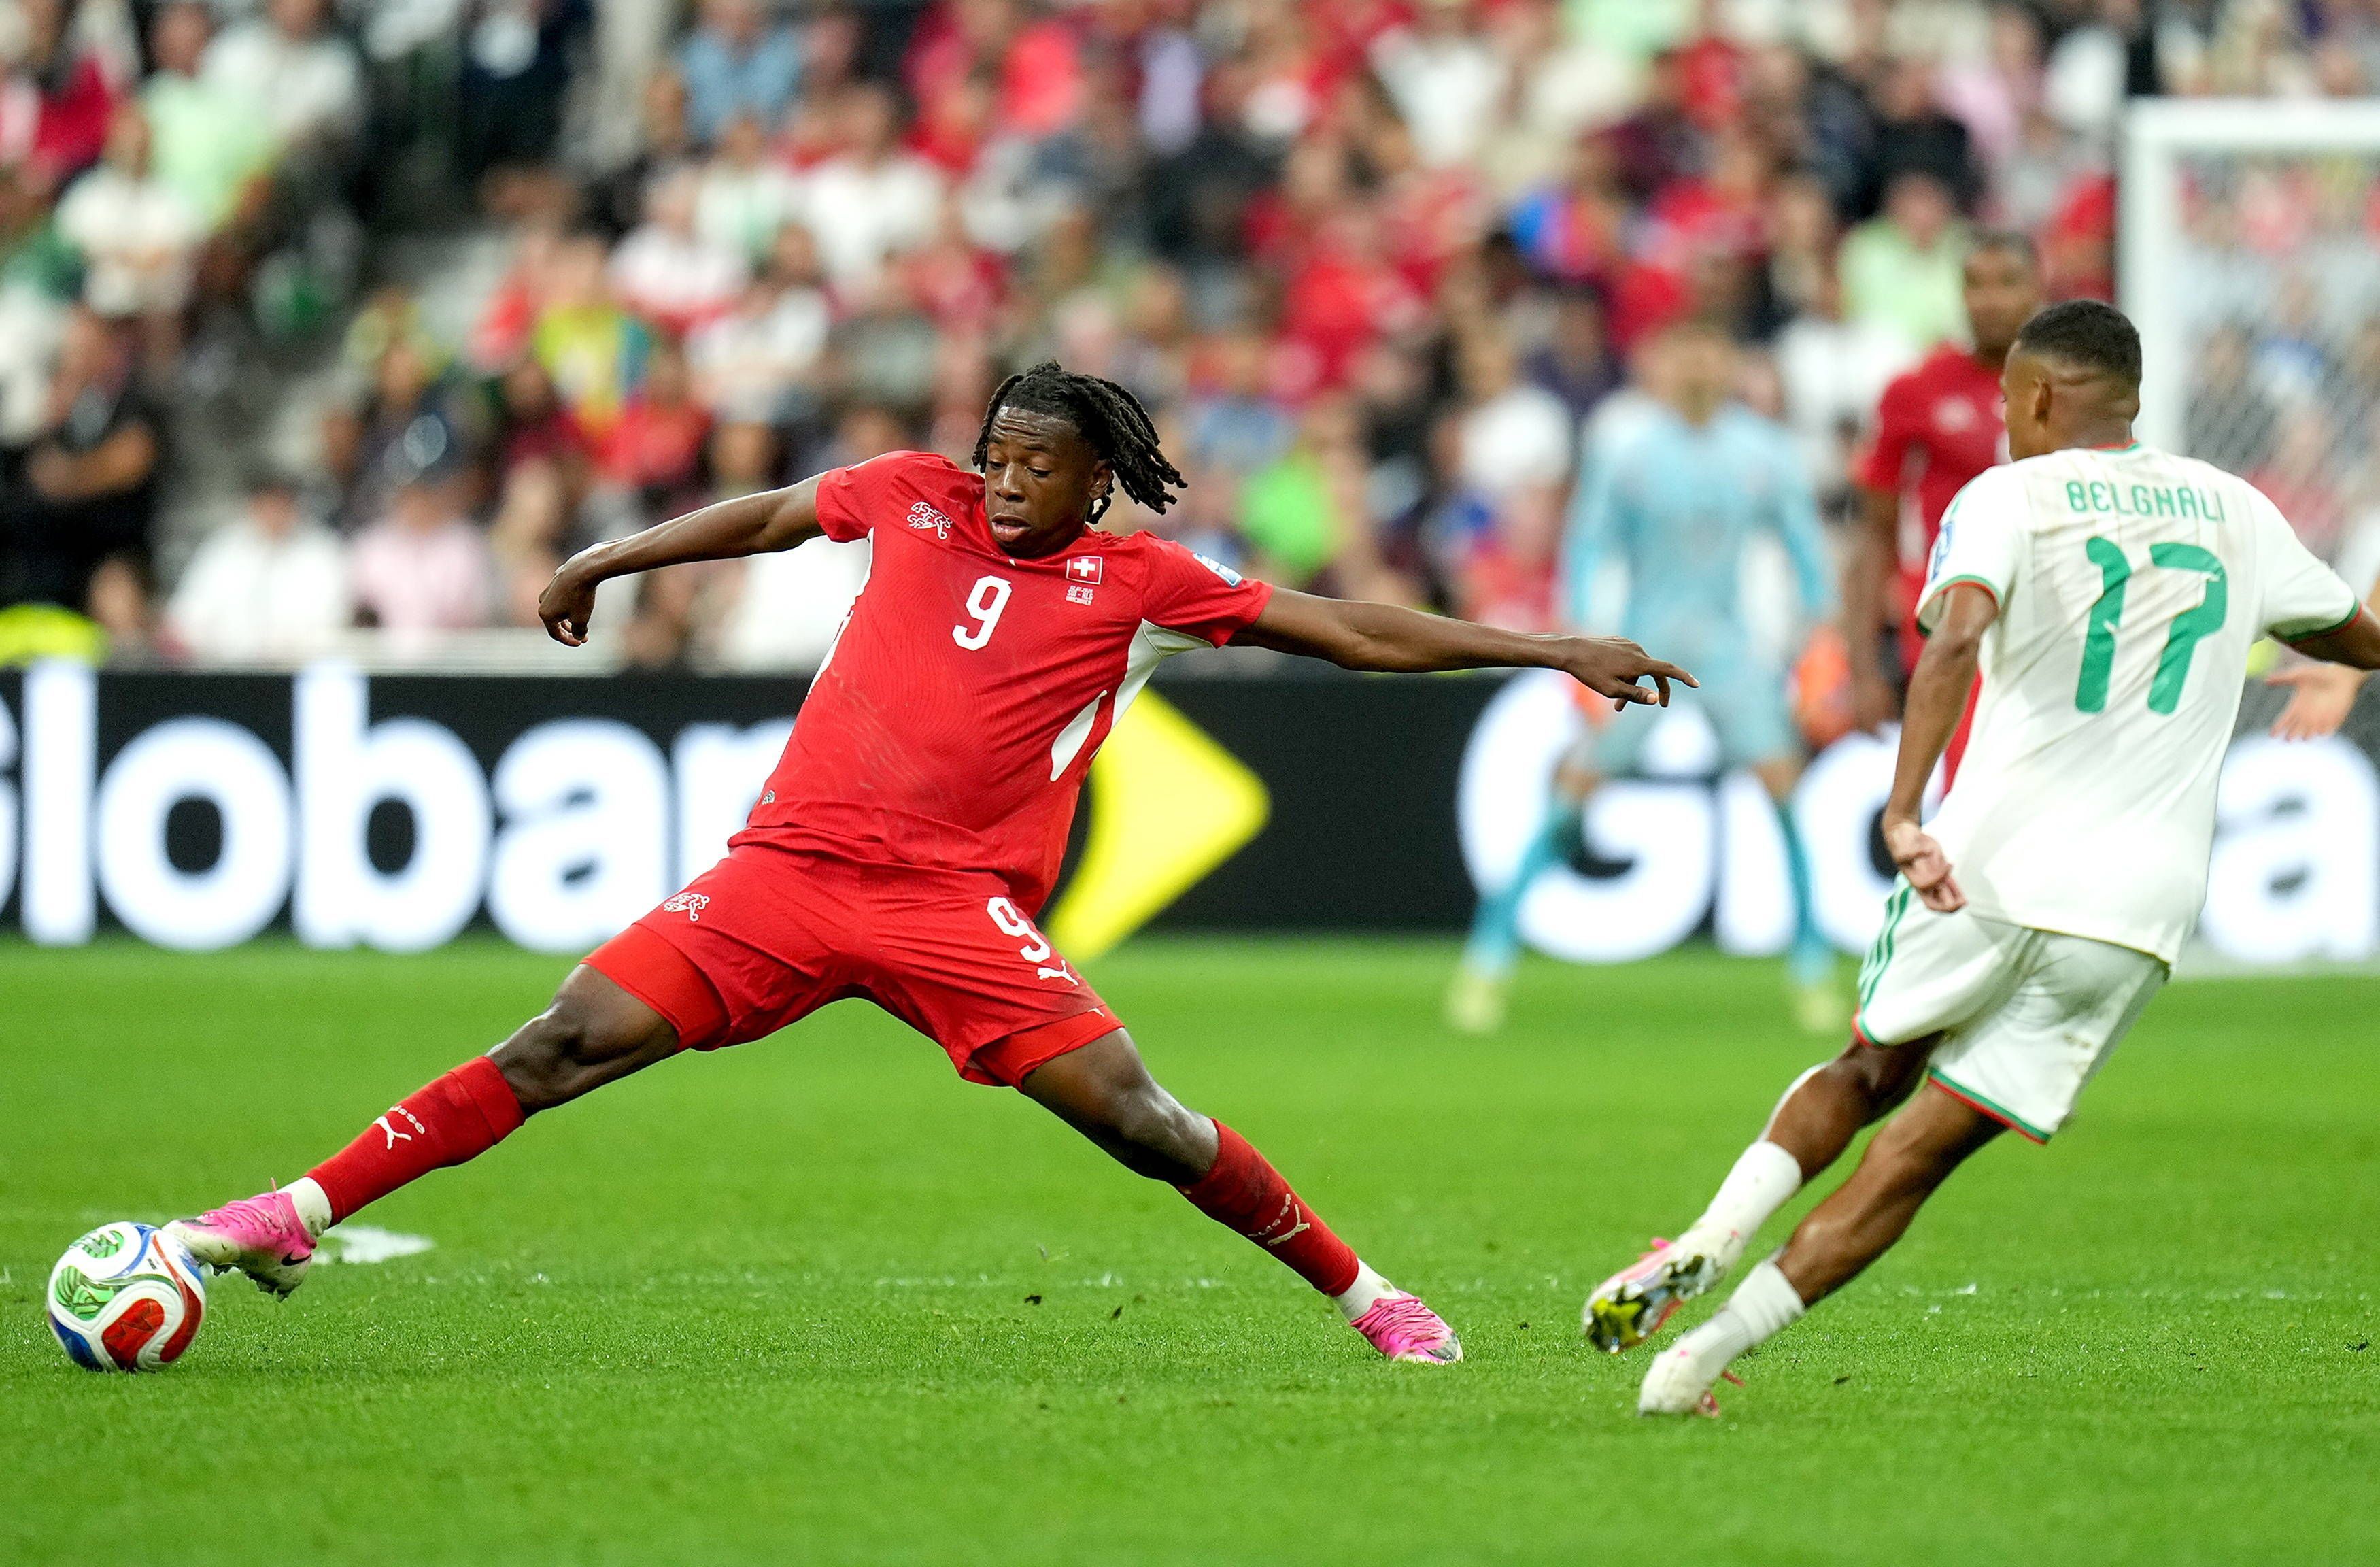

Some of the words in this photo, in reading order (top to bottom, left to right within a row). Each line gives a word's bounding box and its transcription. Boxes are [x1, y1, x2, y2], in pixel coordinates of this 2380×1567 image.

[2066, 480, 2226, 522] BELGHALI
[952, 575, 1013, 651] 9
[2075, 535, 2228, 716] 17
[987, 896, 1051, 963] 9
